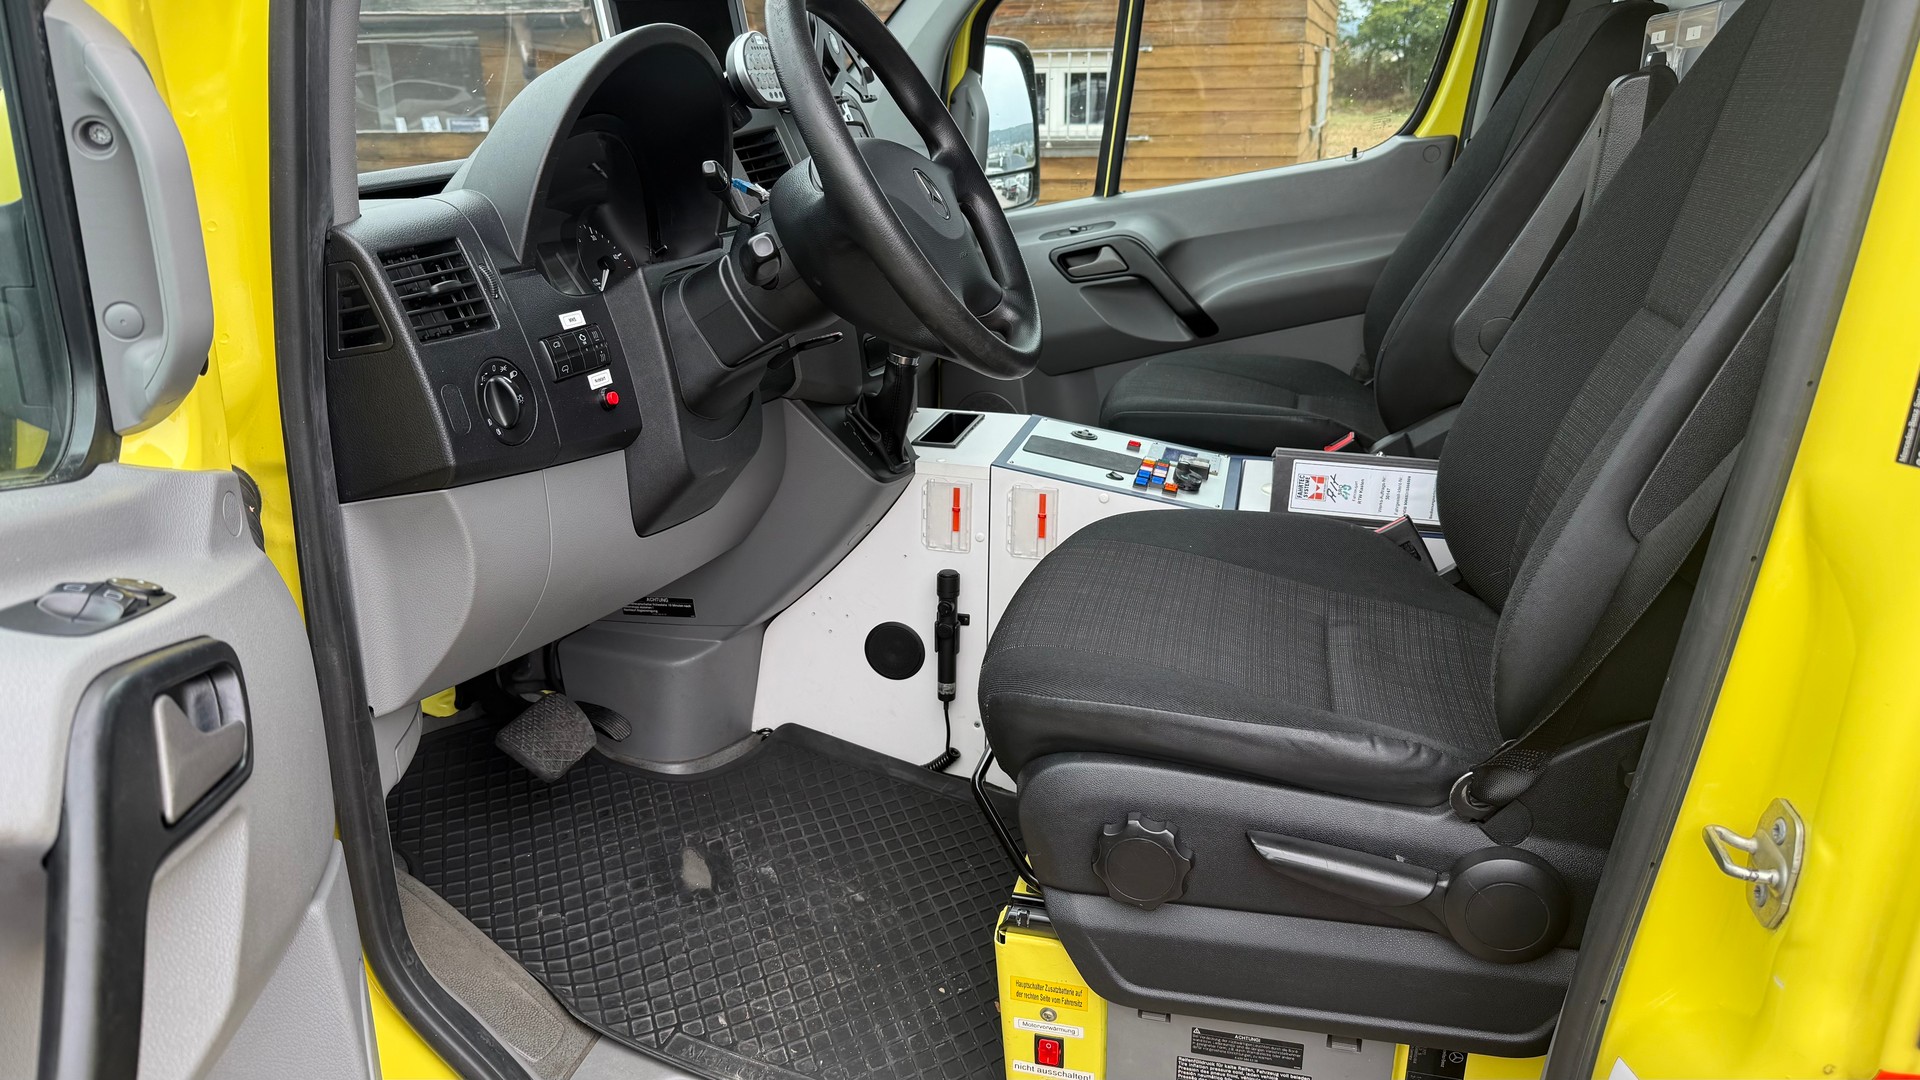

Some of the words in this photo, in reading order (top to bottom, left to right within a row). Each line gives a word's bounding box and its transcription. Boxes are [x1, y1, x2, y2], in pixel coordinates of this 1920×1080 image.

[1297, 474, 1305, 498] FAHRTEC
[1045, 984, 1075, 995] Zusatzbatterie
[1023, 992, 1039, 1000] rechten
[1039, 994, 1051, 1003] Seite
[1061, 998, 1083, 1007] Fahrersitz
[1022, 1021, 1076, 1035] Motorvorwärmung
[1014, 1062, 1035, 1072] nicht
[1036, 1068, 1091, 1080] ausschalten!
